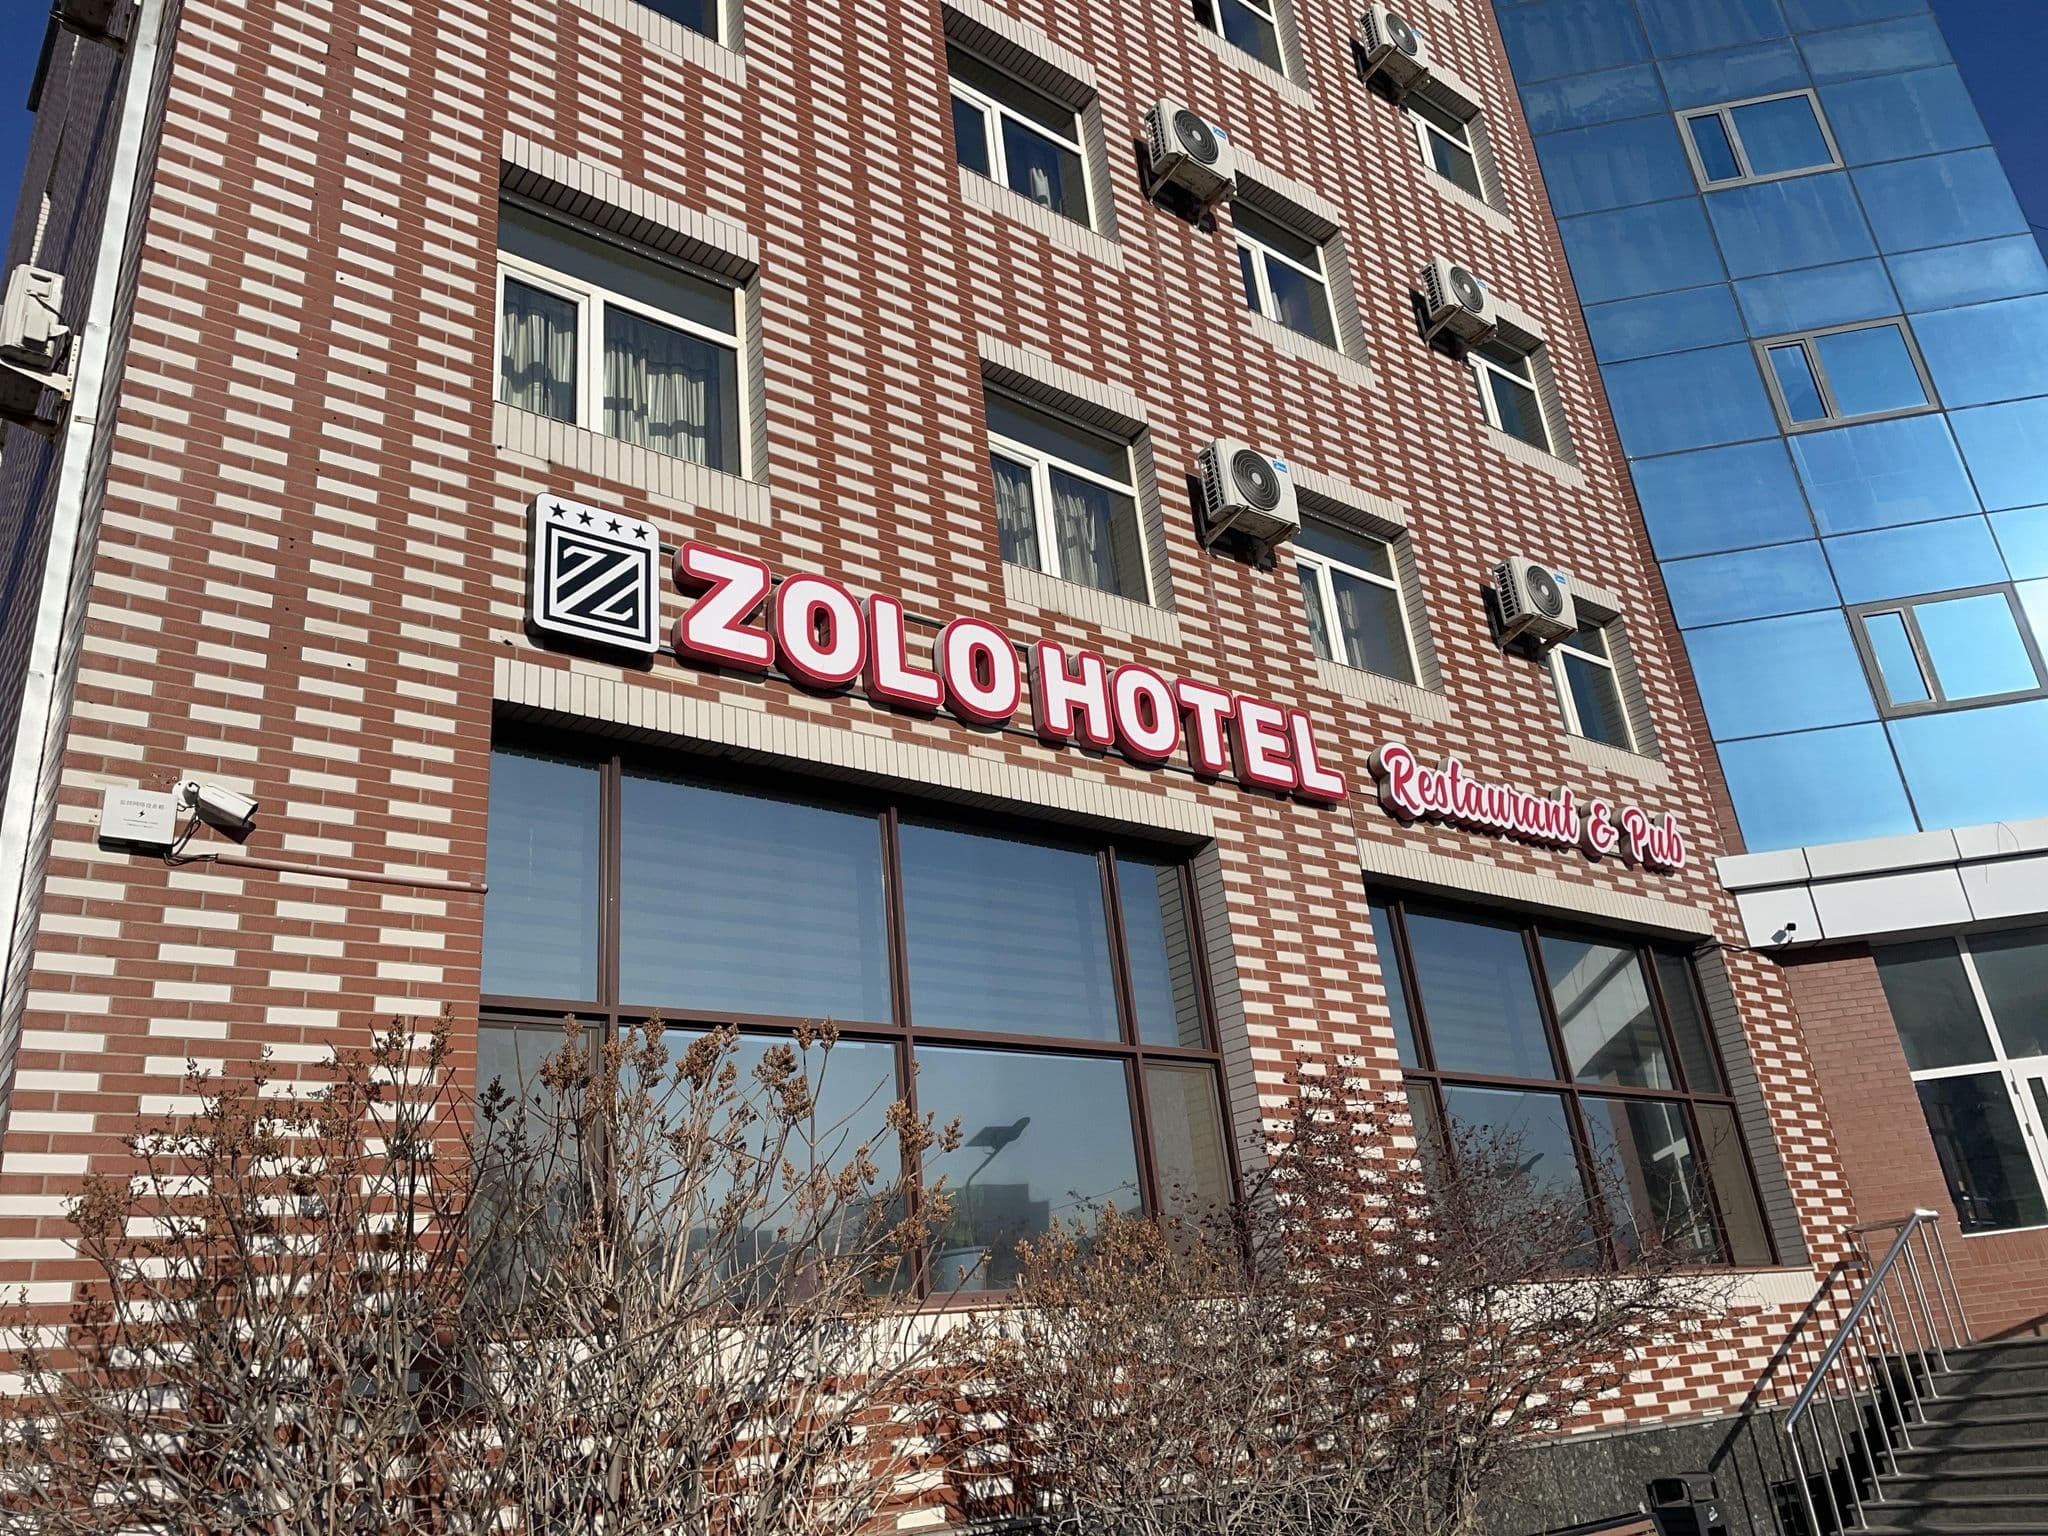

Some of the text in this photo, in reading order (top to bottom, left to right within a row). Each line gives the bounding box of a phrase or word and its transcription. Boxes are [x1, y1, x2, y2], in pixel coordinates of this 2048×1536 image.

[681, 541, 1348, 800] ZOLO HOTEL
[1382, 744, 1685, 867] Restaurant & Pub
